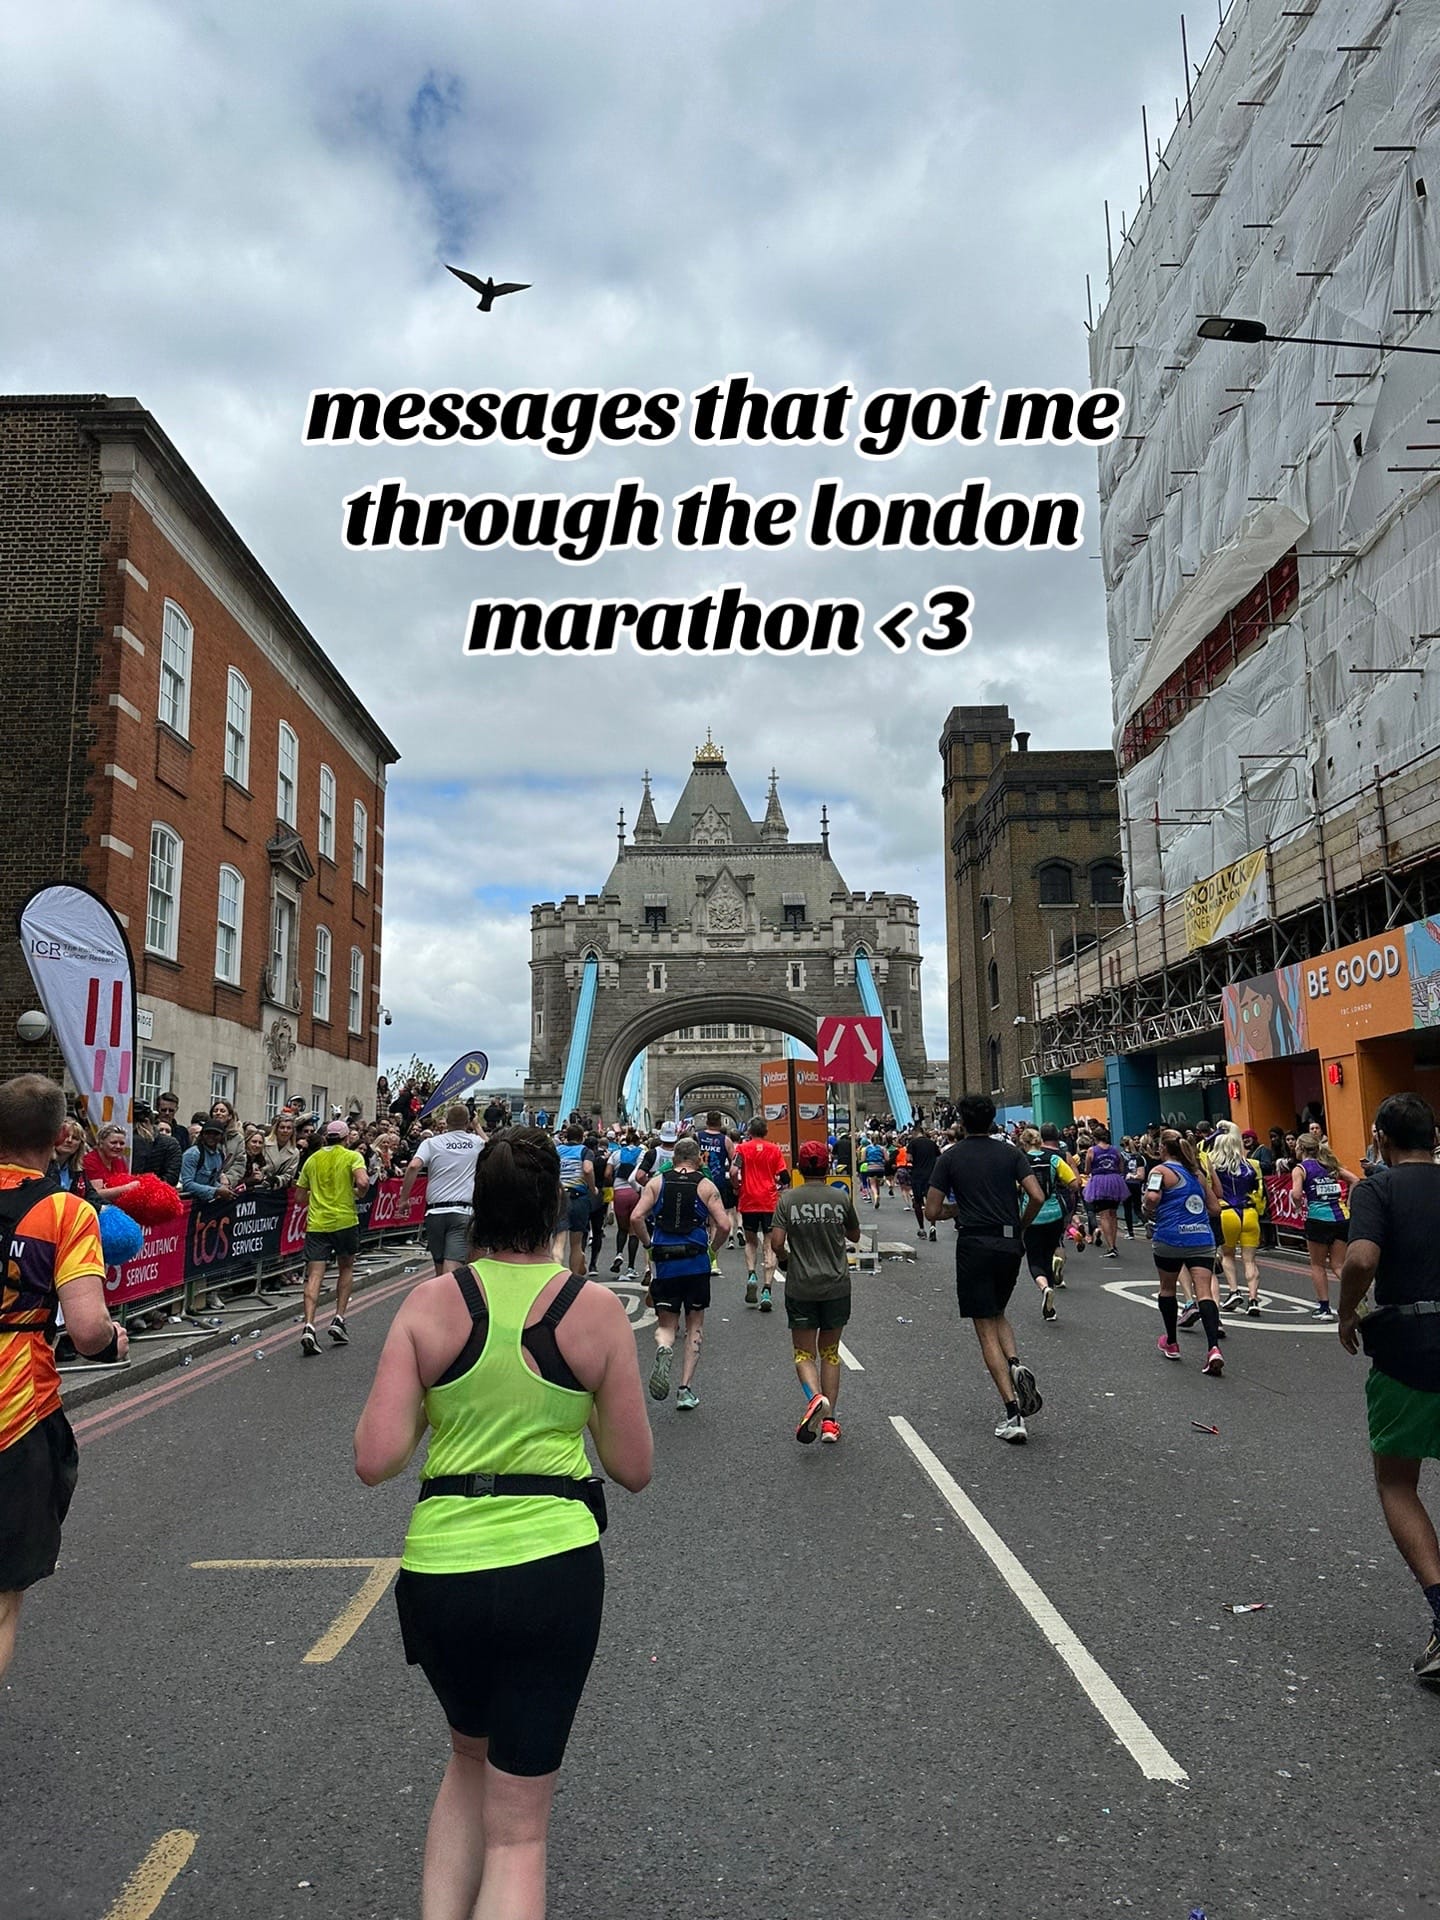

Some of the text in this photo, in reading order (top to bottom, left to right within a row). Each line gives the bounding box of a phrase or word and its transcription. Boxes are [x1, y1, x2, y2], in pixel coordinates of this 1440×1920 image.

[1217, 864, 1247, 895] LUCK
[31, 939, 61, 956] ICR
[1307, 944, 1400, 998] BE GOOD
[446, 1141, 474, 1150] 20326
[700, 1144, 721, 1153] LUKE
[236, 1201, 256, 1218] TATA
[374, 1187, 397, 1221] tcs
[790, 1203, 845, 1220] ASICS
[232, 1215, 280, 1237] CONSULTANCY
[287, 1203, 309, 1243] tc
[128, 1235, 180, 1262] NSULTANCY
[193, 1211, 231, 1266] tcs
[231, 1237, 264, 1257] SERVICES
[126, 1262, 159, 1288] SERVICES
